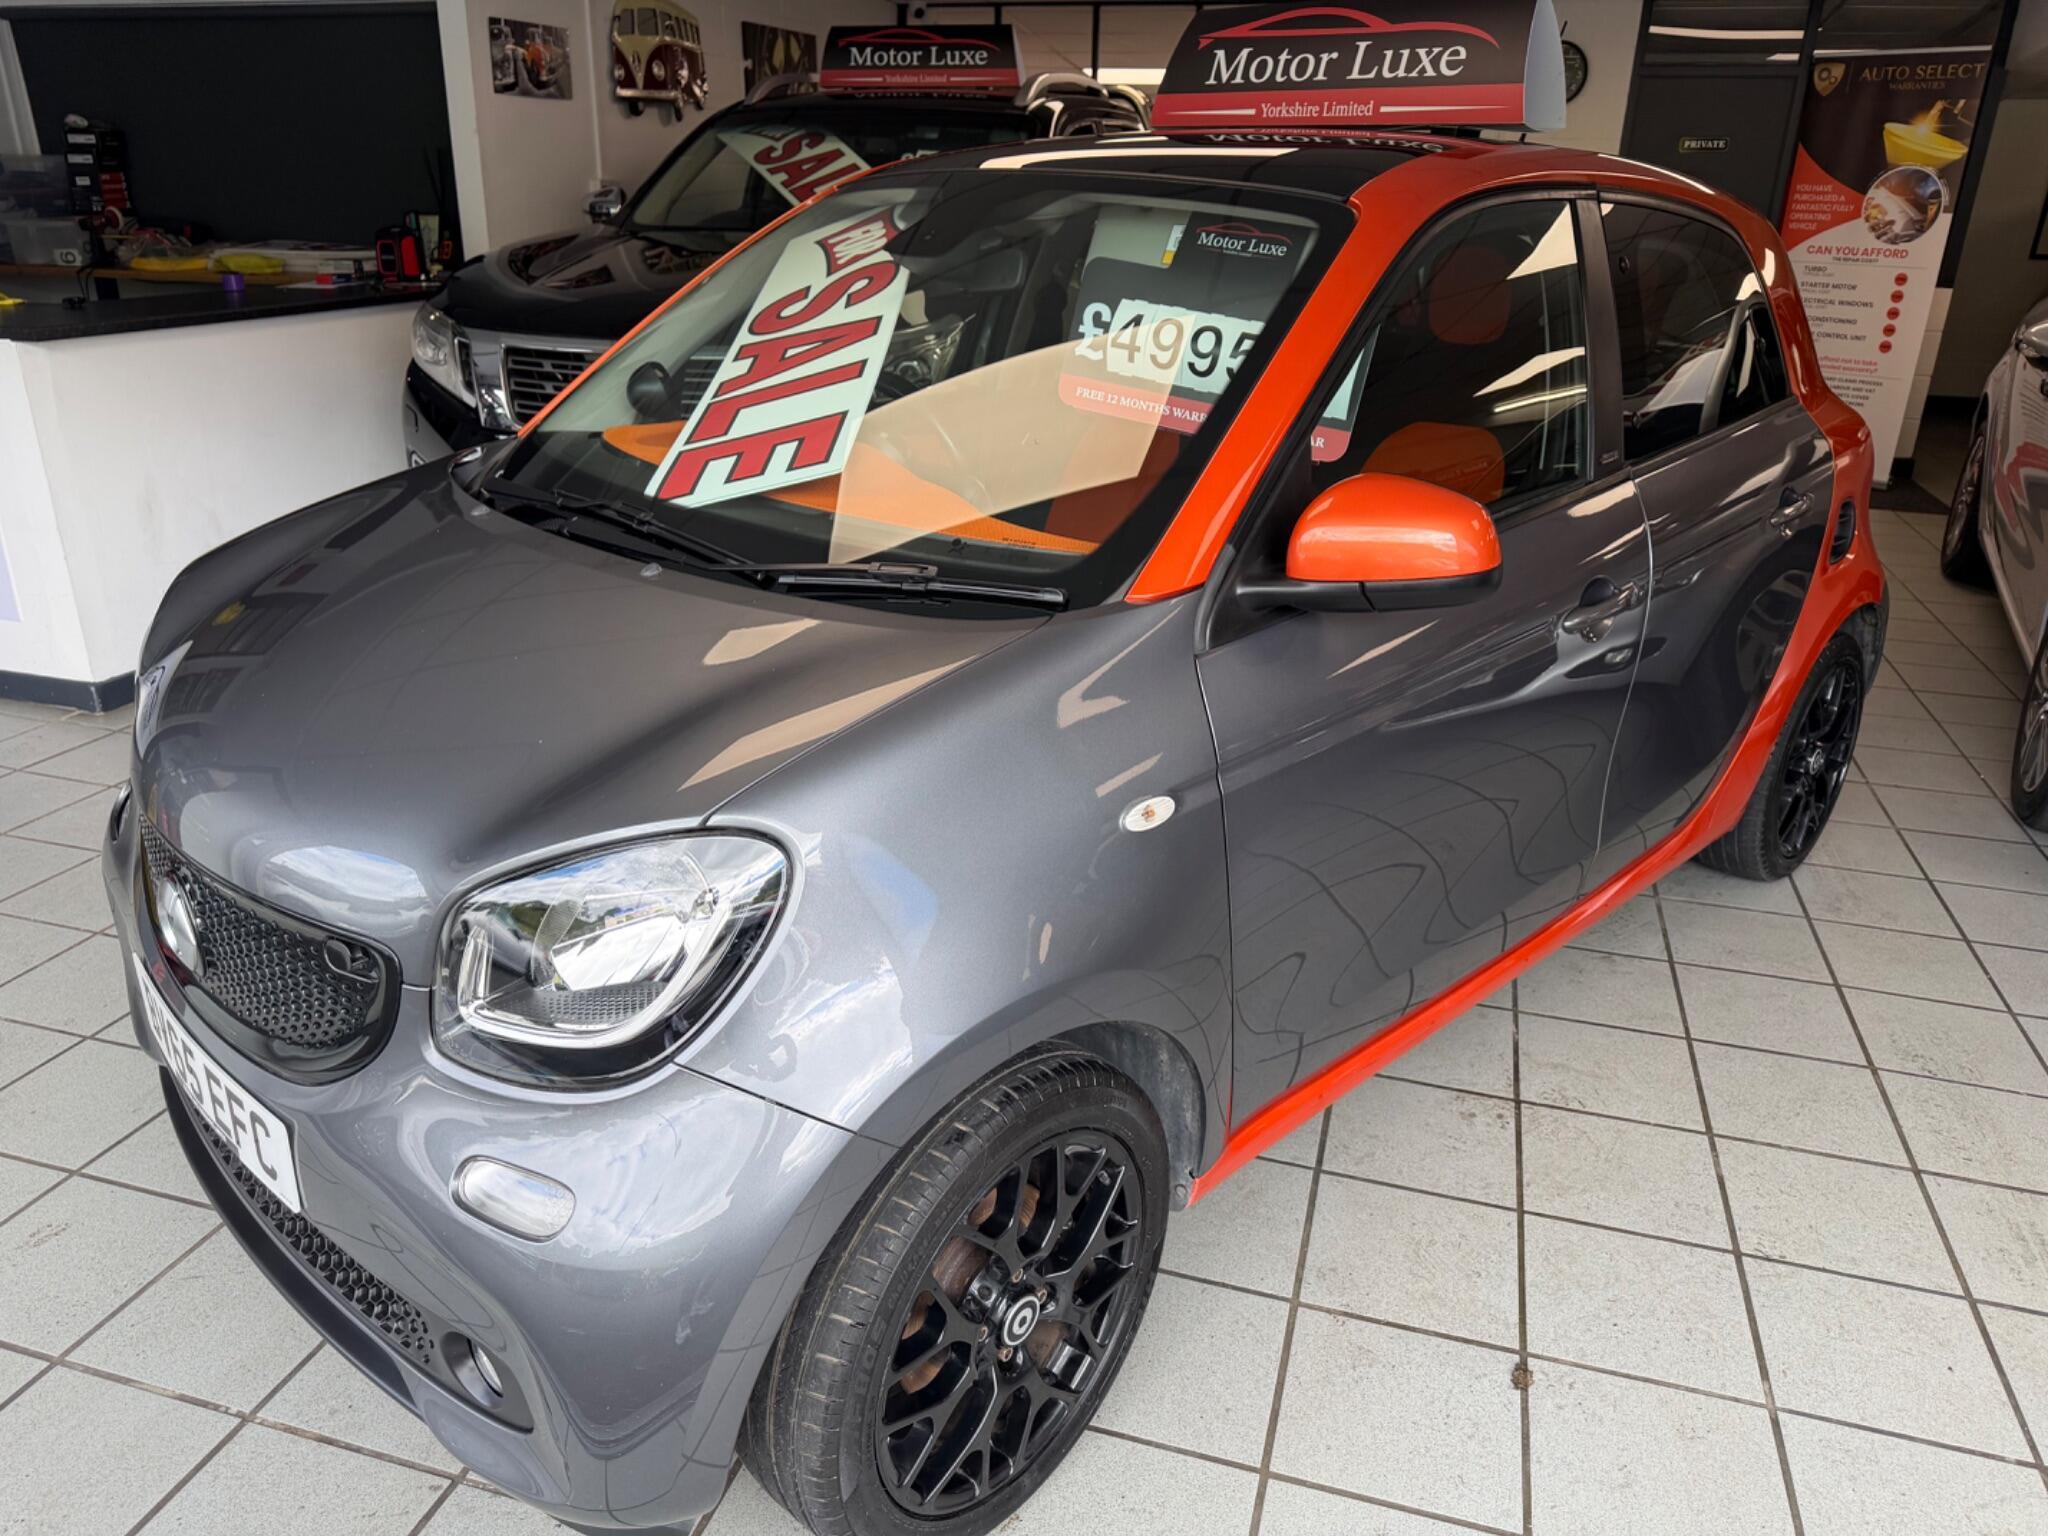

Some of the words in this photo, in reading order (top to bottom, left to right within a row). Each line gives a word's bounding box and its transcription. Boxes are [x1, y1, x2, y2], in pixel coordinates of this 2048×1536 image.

[849, 46, 923, 66] Motor
[929, 46, 988, 66] Luxe
[1204, 48, 1340, 86] Motor
[1346, 40, 1467, 81] Luxe
[1859, 66, 1909, 81] AUTO
[1915, 63, 1985, 79] SELECT
[1260, 102, 1320, 118] Yorkshire
[1322, 100, 1374, 117] Limited
[1683, 140, 1726, 148] PRIVATE
[827, 219, 889, 265] FOR
[1197, 231, 1247, 250] Motor
[1248, 238, 1288, 257] Luxe
[1806, 244, 1833, 255] CAN
[1835, 246, 1860, 256] YOU
[1861, 247, 1909, 259] AFFORD
[1804, 265, 1828, 273] TURBO
[1802, 298, 1836, 306] ECTRICAL
[655, 260, 900, 500] SALE
[1075, 386, 1105, 401] FREE
[1107, 393, 1119, 404] 12
[1119, 396, 1171, 416] MONTHS
[202, 1062, 278, 1182] EFC
